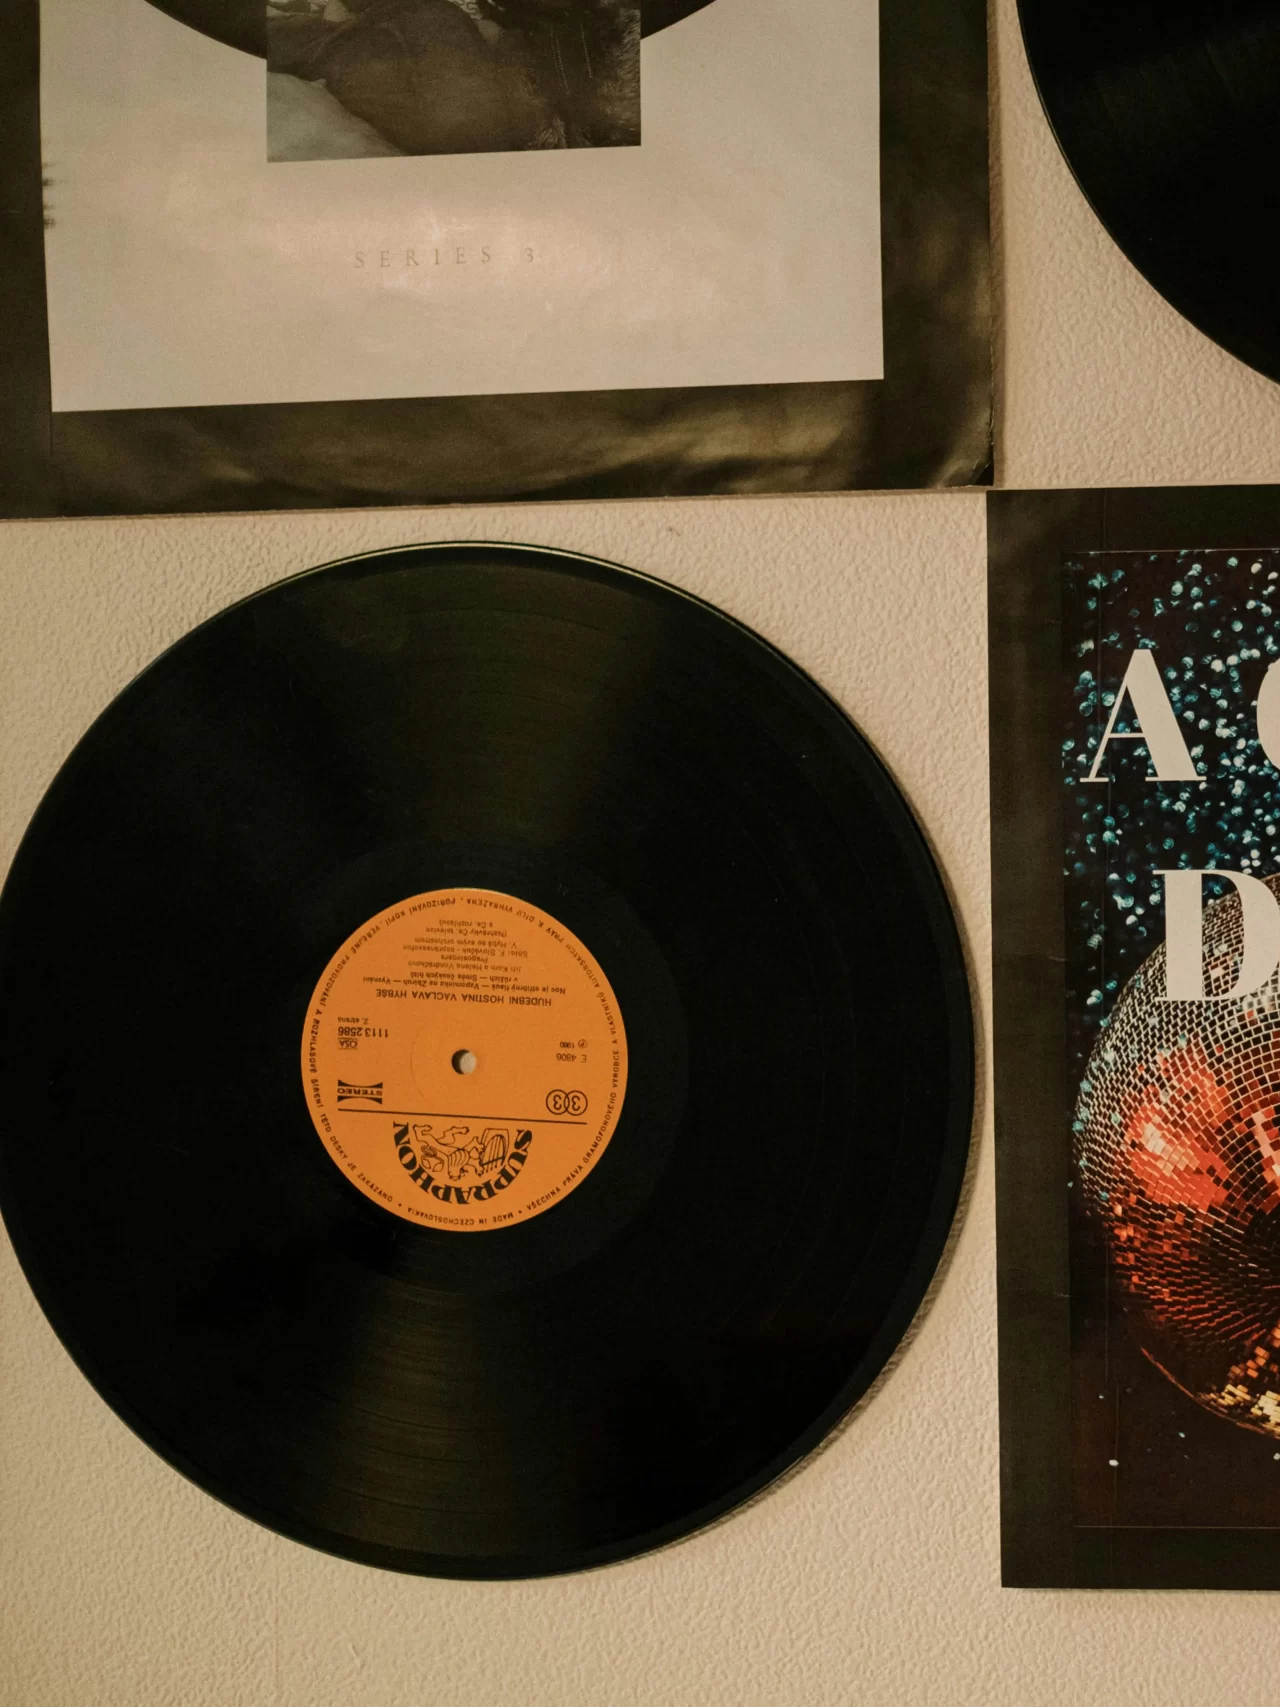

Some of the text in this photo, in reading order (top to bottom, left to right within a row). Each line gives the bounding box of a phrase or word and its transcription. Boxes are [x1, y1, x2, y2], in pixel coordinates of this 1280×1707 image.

[355, 246, 534, 269] SERIES 3
[541, 985, 549, 993] je
[551, 987, 566, 995] Noc
[461, 993, 504, 1004] HOSTINA
[339, 1039, 358, 1049] OSA
[555, 1053, 587, 1063] E 4806
[337, 1088, 383, 1096] STEREO
[393, 1121, 532, 1205] SUPRAPHON
[406, 1206, 514, 1226] MADE IN CZECHOSLOVAKIA
